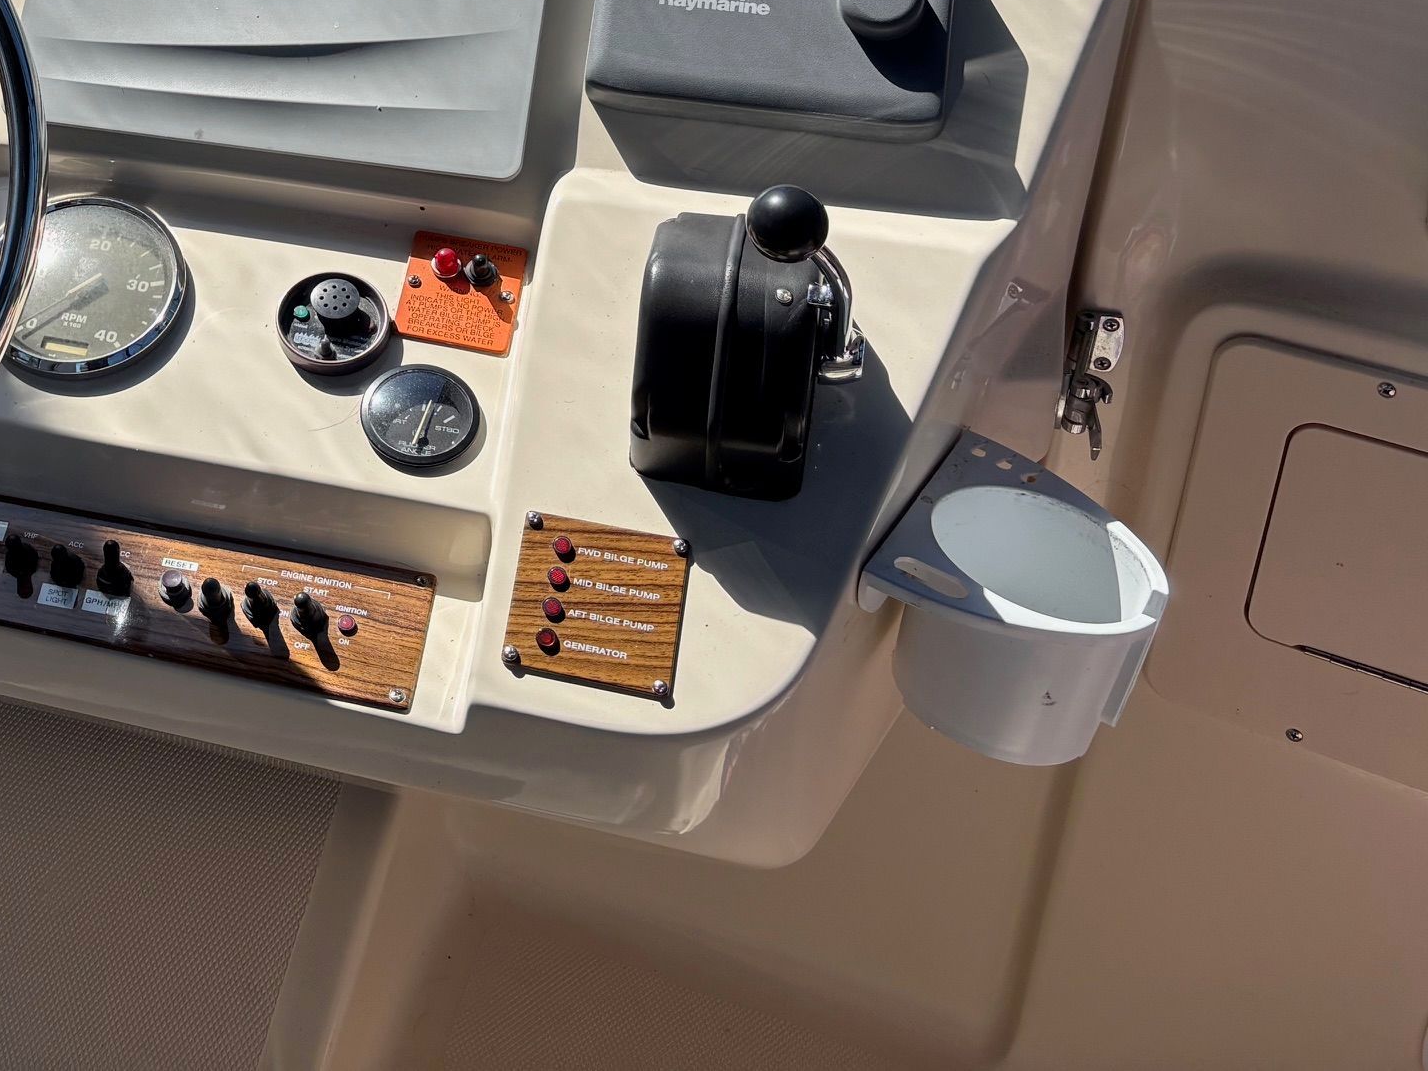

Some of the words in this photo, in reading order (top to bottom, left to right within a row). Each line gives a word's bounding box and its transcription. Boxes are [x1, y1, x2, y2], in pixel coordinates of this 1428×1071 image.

[89, 240, 112, 252] 20
[126, 279, 150, 292] 30
[436, 292, 454, 302] THIS
[457, 296, 480, 305] LIGHT
[410, 294, 455, 307] INDICATES
[457, 302, 470, 310] NO
[472, 305, 504, 317] POWER
[419, 301, 449, 312] PUMPS
[466, 309, 481, 318] THE
[61, 312, 88, 324] RPM
[407, 305, 438, 316] WATER
[439, 310, 465, 321] BILGE
[466, 316, 491, 325] PUMP
[25, 320, 38, 329] 0
[408, 317, 454, 332] BREAKERS
[455, 326, 468, 335] OR
[469, 328, 496, 340] BILGE
[464, 322, 494, 333] CHECK
[94, 330, 118, 342] 40
[406, 325, 425, 333] FOR
[427, 328, 461, 340] EXCESS
[463, 334, 494, 346] WATER
[435, 425, 460, 434] STBD
[164, 559, 194, 570] RESET
[578, 547, 602, 558] FWD
[604, 551, 634, 565] BILGE
[636, 558, 669, 571] PUMP
[257, 577, 279, 586] STOP
[281, 570, 313, 582] ENGINE
[314, 576, 352, 589] IGNITION
[47, 589, 68, 597] SPOT
[303, 586, 329, 596] START
[573, 577, 592, 588] MID
[595, 582, 626, 595] BILGE
[629, 588, 660, 601] PUMP
[46, 595, 68, 605] LIGHT
[335, 604, 368, 616] IGNITION
[568, 608, 587, 619] AFT
[589, 612, 620, 626] BILGE
[622, 619, 655, 632] PUMP
[294, 641, 310, 650] OFF
[338, 638, 350, 646] ON
[563, 640, 628, 660] GENERATOR
